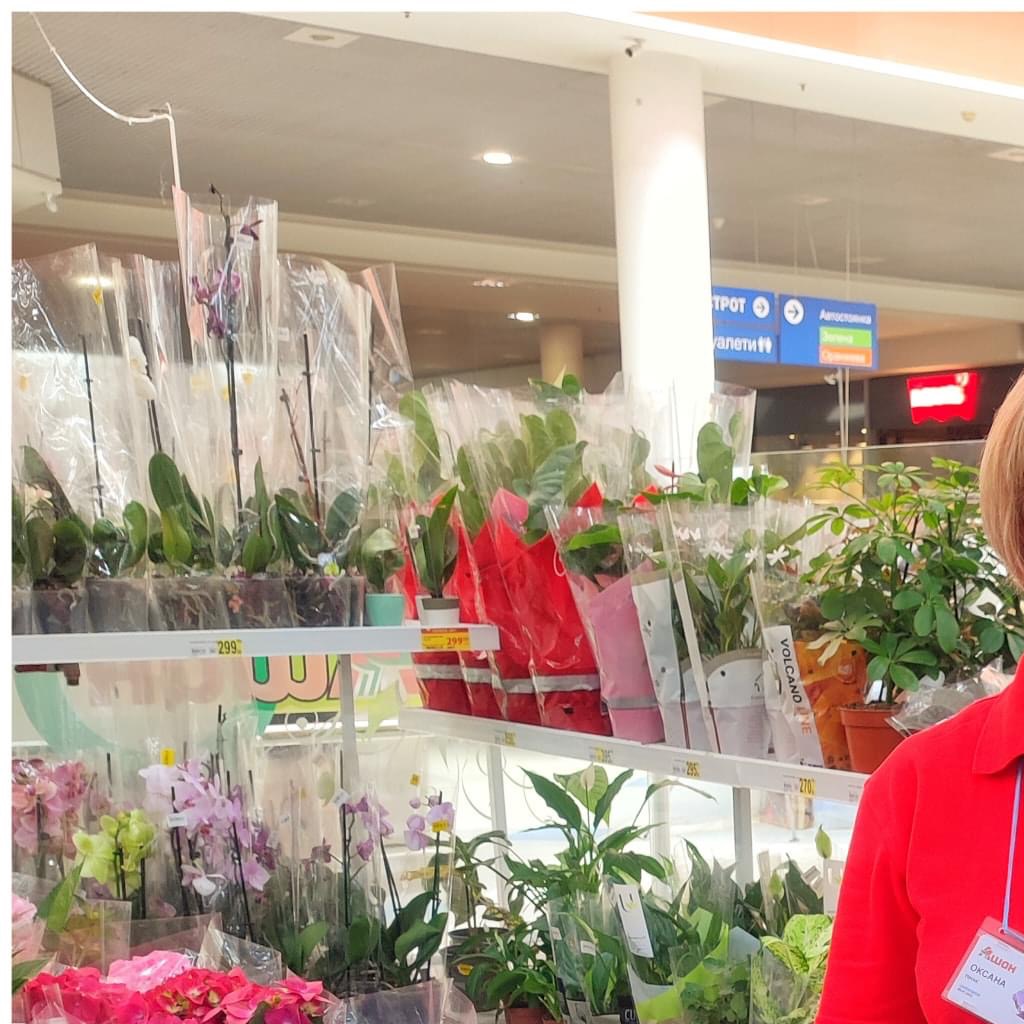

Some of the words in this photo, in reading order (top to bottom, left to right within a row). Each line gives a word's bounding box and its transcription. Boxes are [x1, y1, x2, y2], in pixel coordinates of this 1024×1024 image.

[712, 295, 746, 313] ТРОТ
[217, 640, 237, 655] 299
[780, 638, 803, 704] VOLCANO
[800, 777, 812, 795] 270
[969, 963, 1007, 989] ОКСАНА
